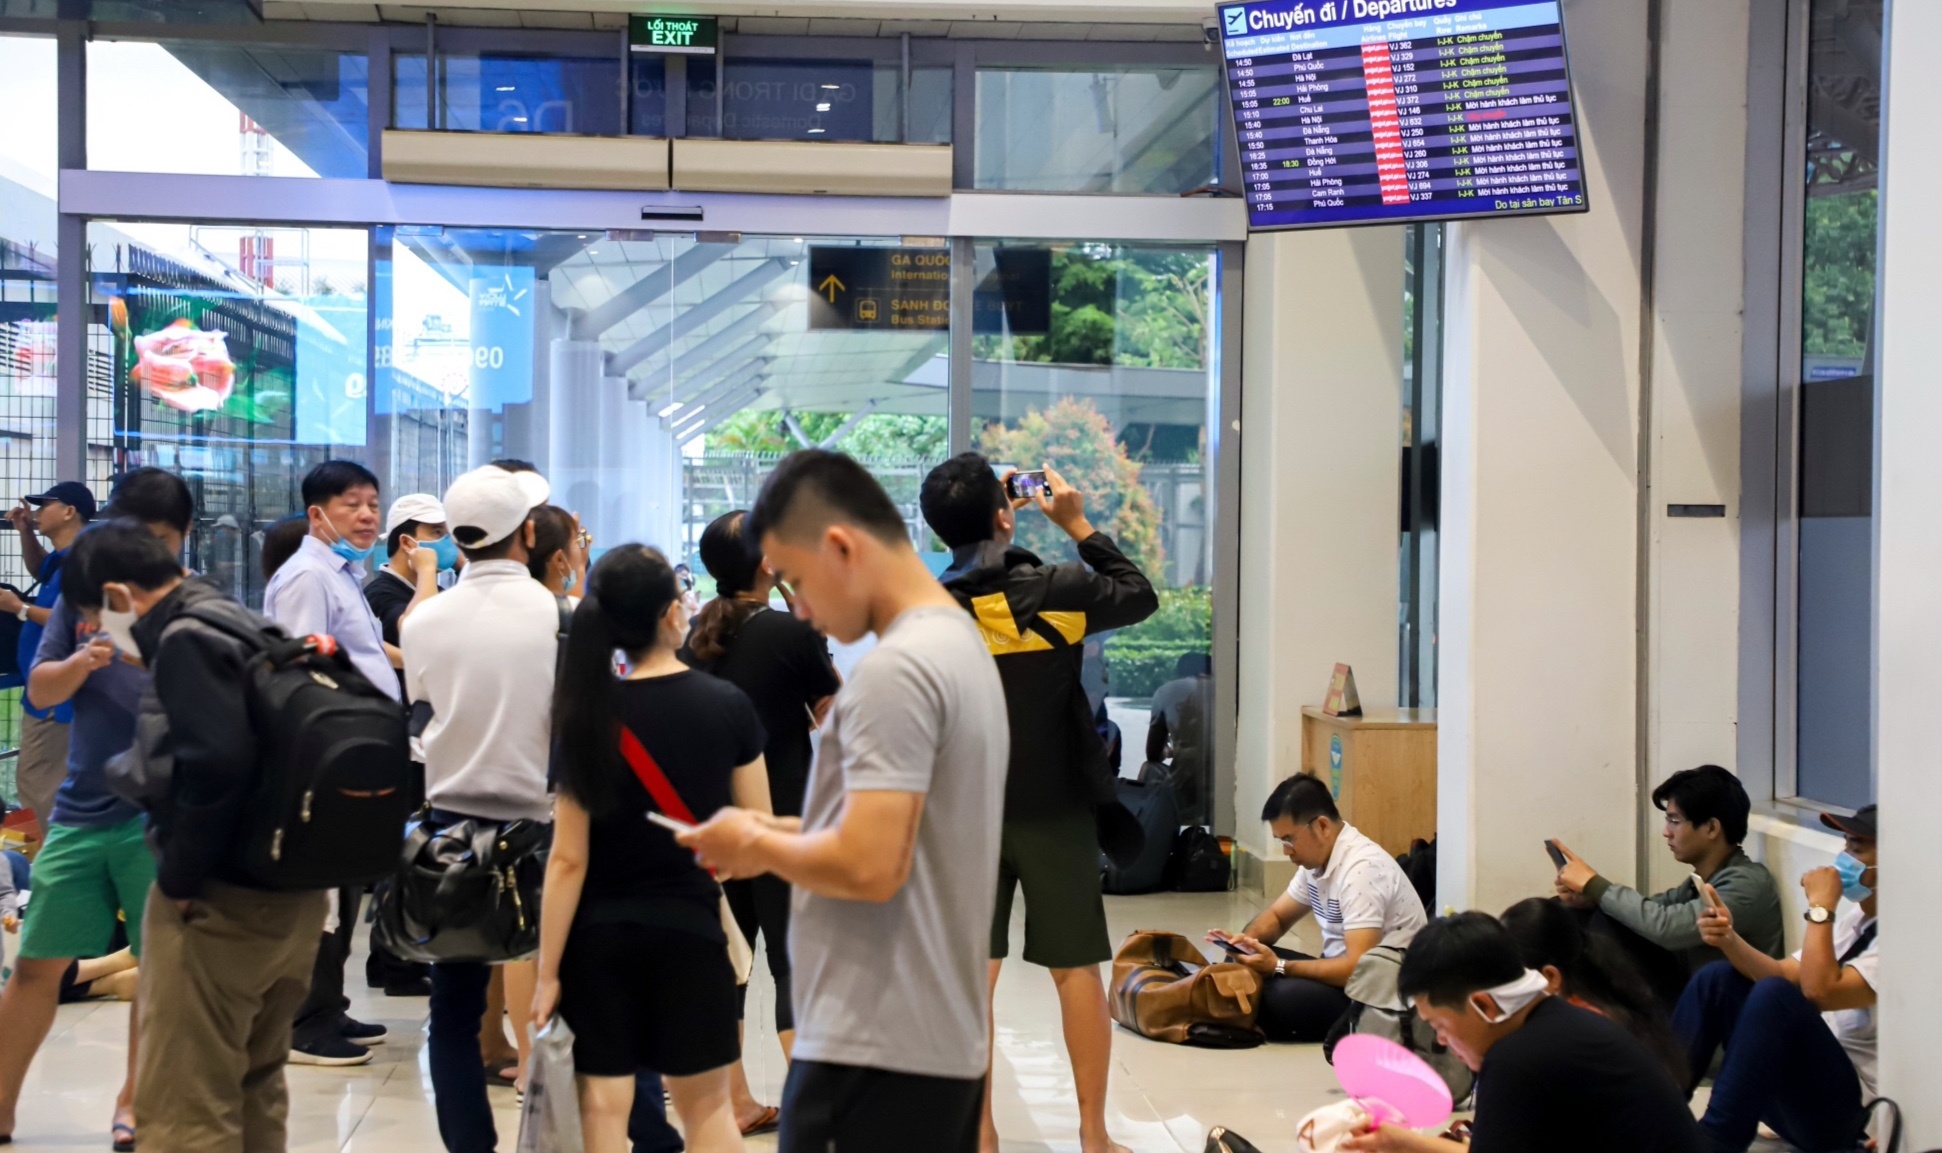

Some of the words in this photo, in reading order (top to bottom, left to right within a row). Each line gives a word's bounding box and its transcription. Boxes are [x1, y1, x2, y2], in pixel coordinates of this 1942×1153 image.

[1249, 3, 1315, 30] Chuyến
[1320, 1, 1336, 22] đi
[1342, 0, 1348, 20] /
[1354, 0, 1457, 19] Departures
[647, 18, 664, 30] LỐI
[666, 21, 698, 31] THOÁT
[652, 30, 693, 45] EXIT
[1388, 32, 1407, 40] Flight
[1495, 200, 1507, 208] Do
[1508, 199, 1519, 209] tại
[1521, 198, 1536, 207] sân
[1539, 197, 1554, 207] bay
[1556, 195, 1572, 204] Tân
[891, 254, 911, 266] GA
[891, 269, 949, 281] Internatio
[891, 314, 914, 324] Bus
